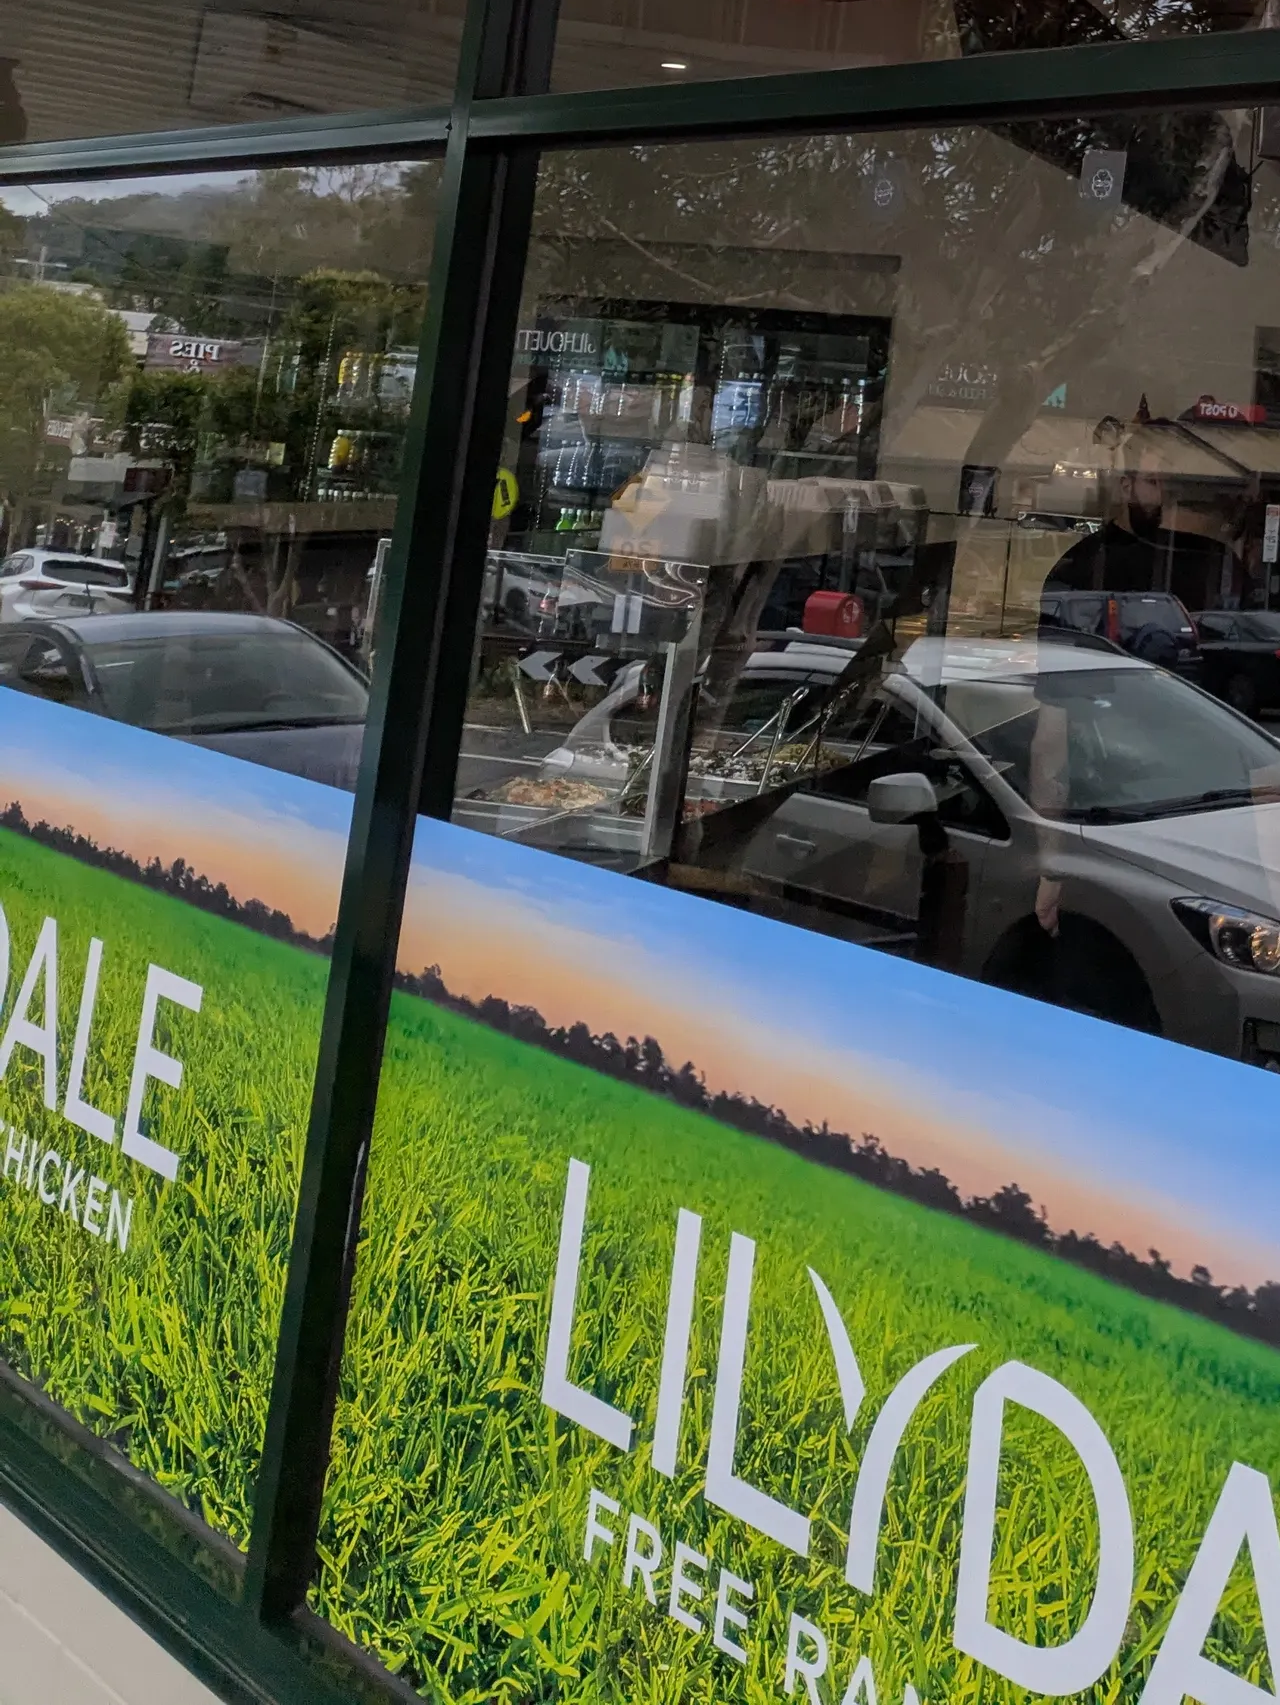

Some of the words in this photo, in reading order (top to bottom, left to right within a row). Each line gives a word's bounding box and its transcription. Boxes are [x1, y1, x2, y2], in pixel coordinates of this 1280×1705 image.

[0, 904, 203, 1182] ALE
[0, 1119, 133, 1253] HICKEN
[584, 1488, 753, 1664] FREE
[785, 1612, 918, 1705] RA
